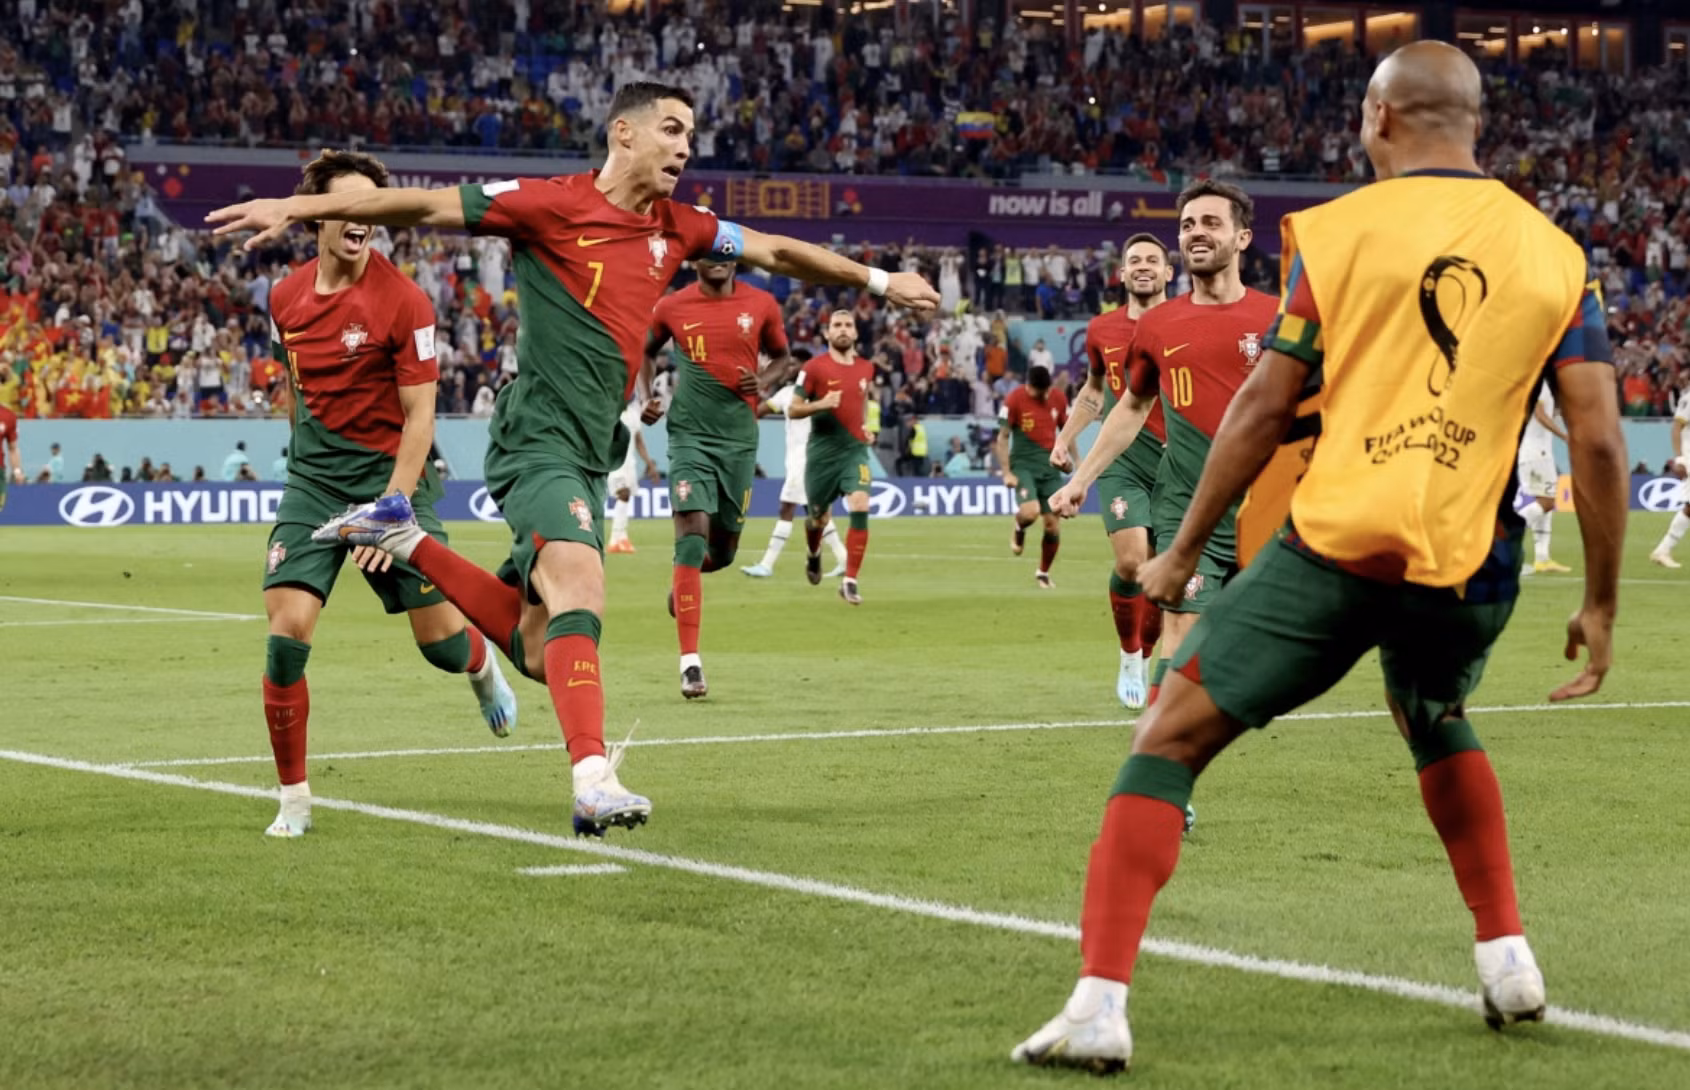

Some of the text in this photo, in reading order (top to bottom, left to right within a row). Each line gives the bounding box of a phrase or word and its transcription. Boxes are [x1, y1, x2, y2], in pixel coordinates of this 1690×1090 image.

[989, 194, 1045, 215] now
[1049, 190, 1068, 216] is
[1072, 190, 1103, 217] all
[584, 261, 604, 308] 7
[687, 334, 707, 362] 14
[1109, 361, 1121, 391] 5
[1169, 367, 1193, 408] 10
[1443, 420, 1476, 447] CUP
[913, 484, 1018, 515] HYUN
